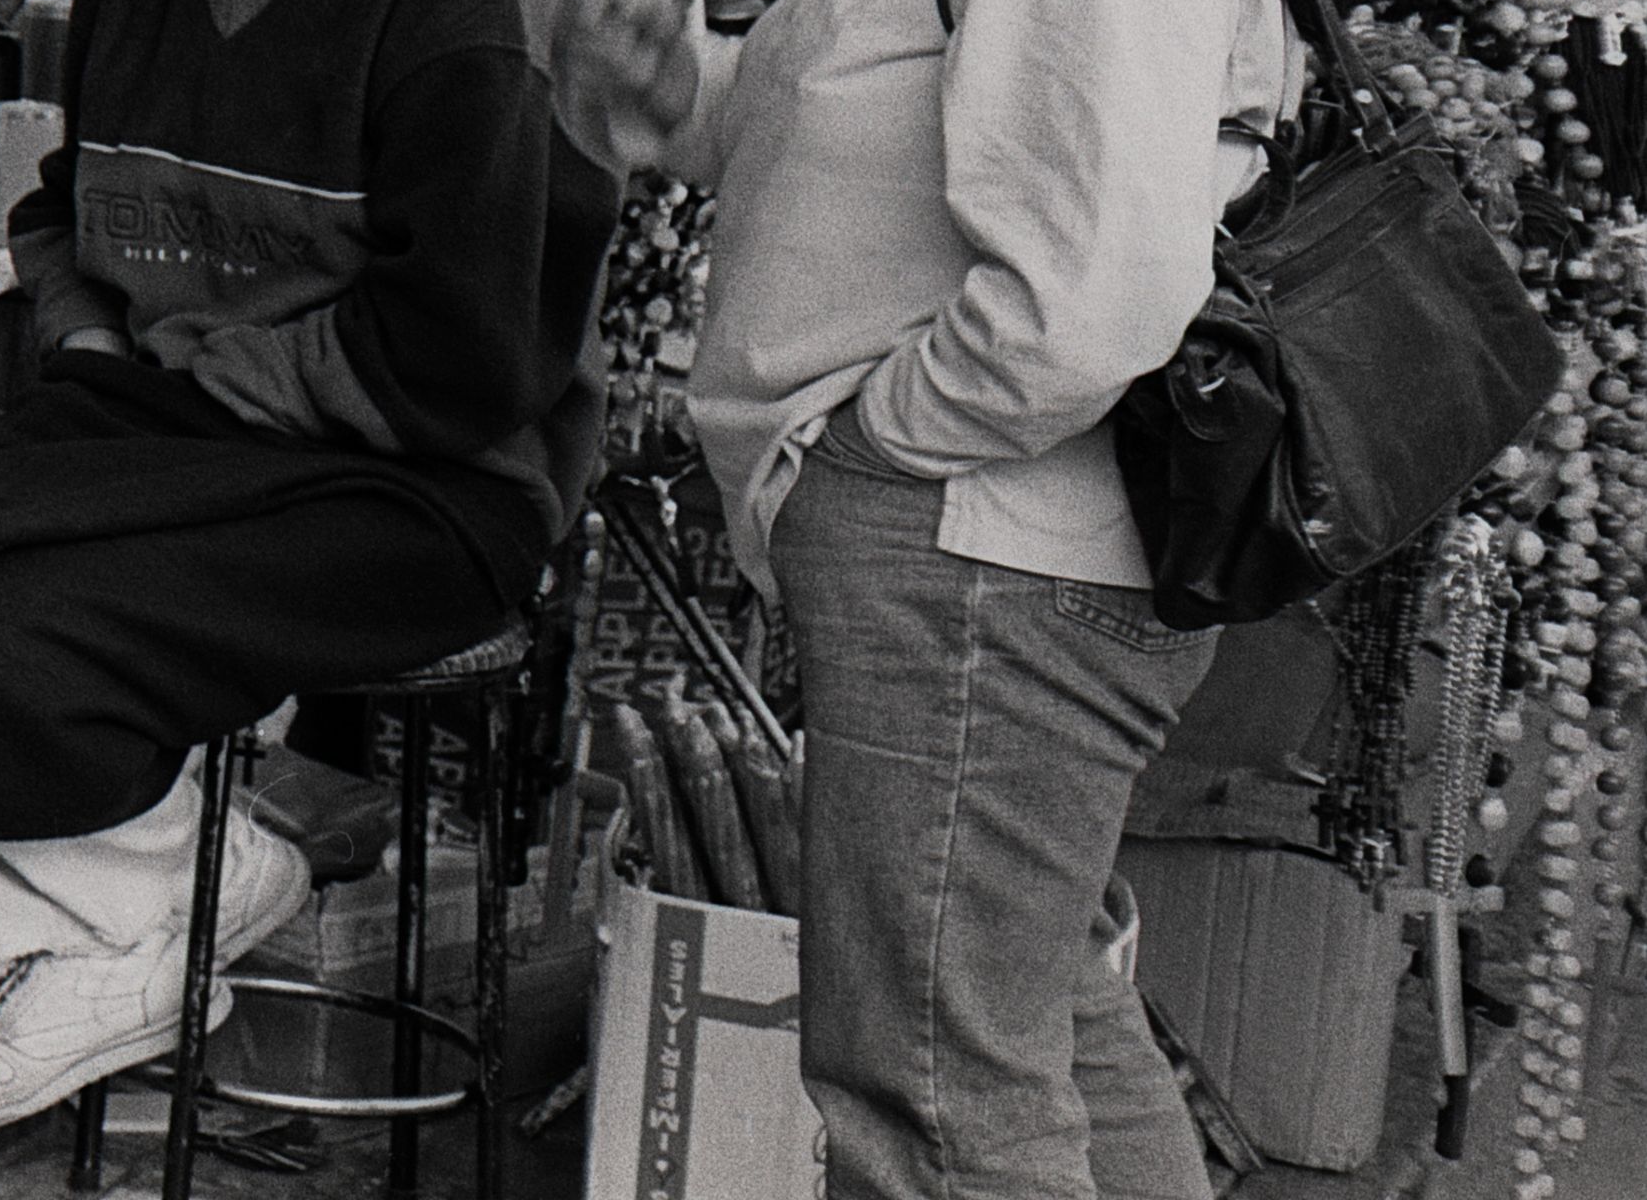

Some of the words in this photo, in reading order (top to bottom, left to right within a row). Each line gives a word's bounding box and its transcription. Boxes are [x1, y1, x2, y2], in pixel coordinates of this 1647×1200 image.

[84, 186, 316, 264] TOMMY
[589, 533, 648, 702] APPLE
[649, 938, 688, 1154] IMPERIALES
